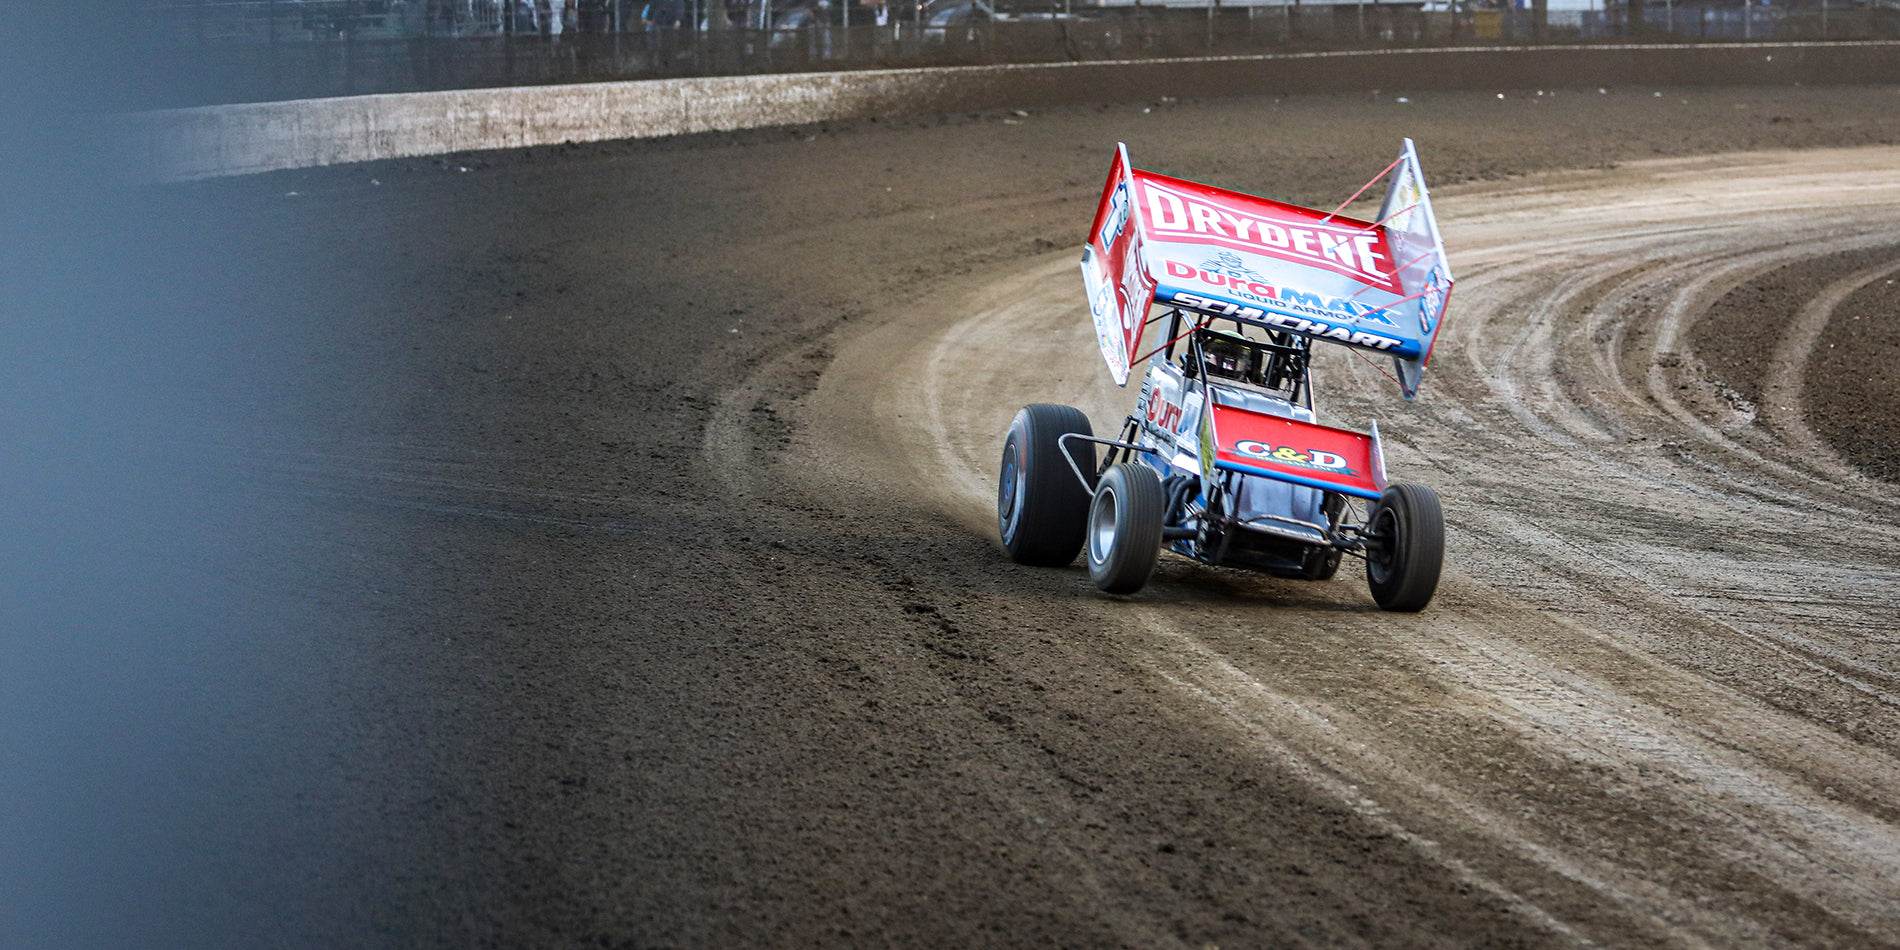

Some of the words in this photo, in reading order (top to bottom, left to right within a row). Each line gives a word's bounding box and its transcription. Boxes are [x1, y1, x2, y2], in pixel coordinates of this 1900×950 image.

[1143, 184, 1390, 280] DRYDENE
[1227, 288, 1287, 308] LIQUID
[1170, 291, 1403, 350] SCHUCHART
[1234, 440, 1347, 470] C&D
